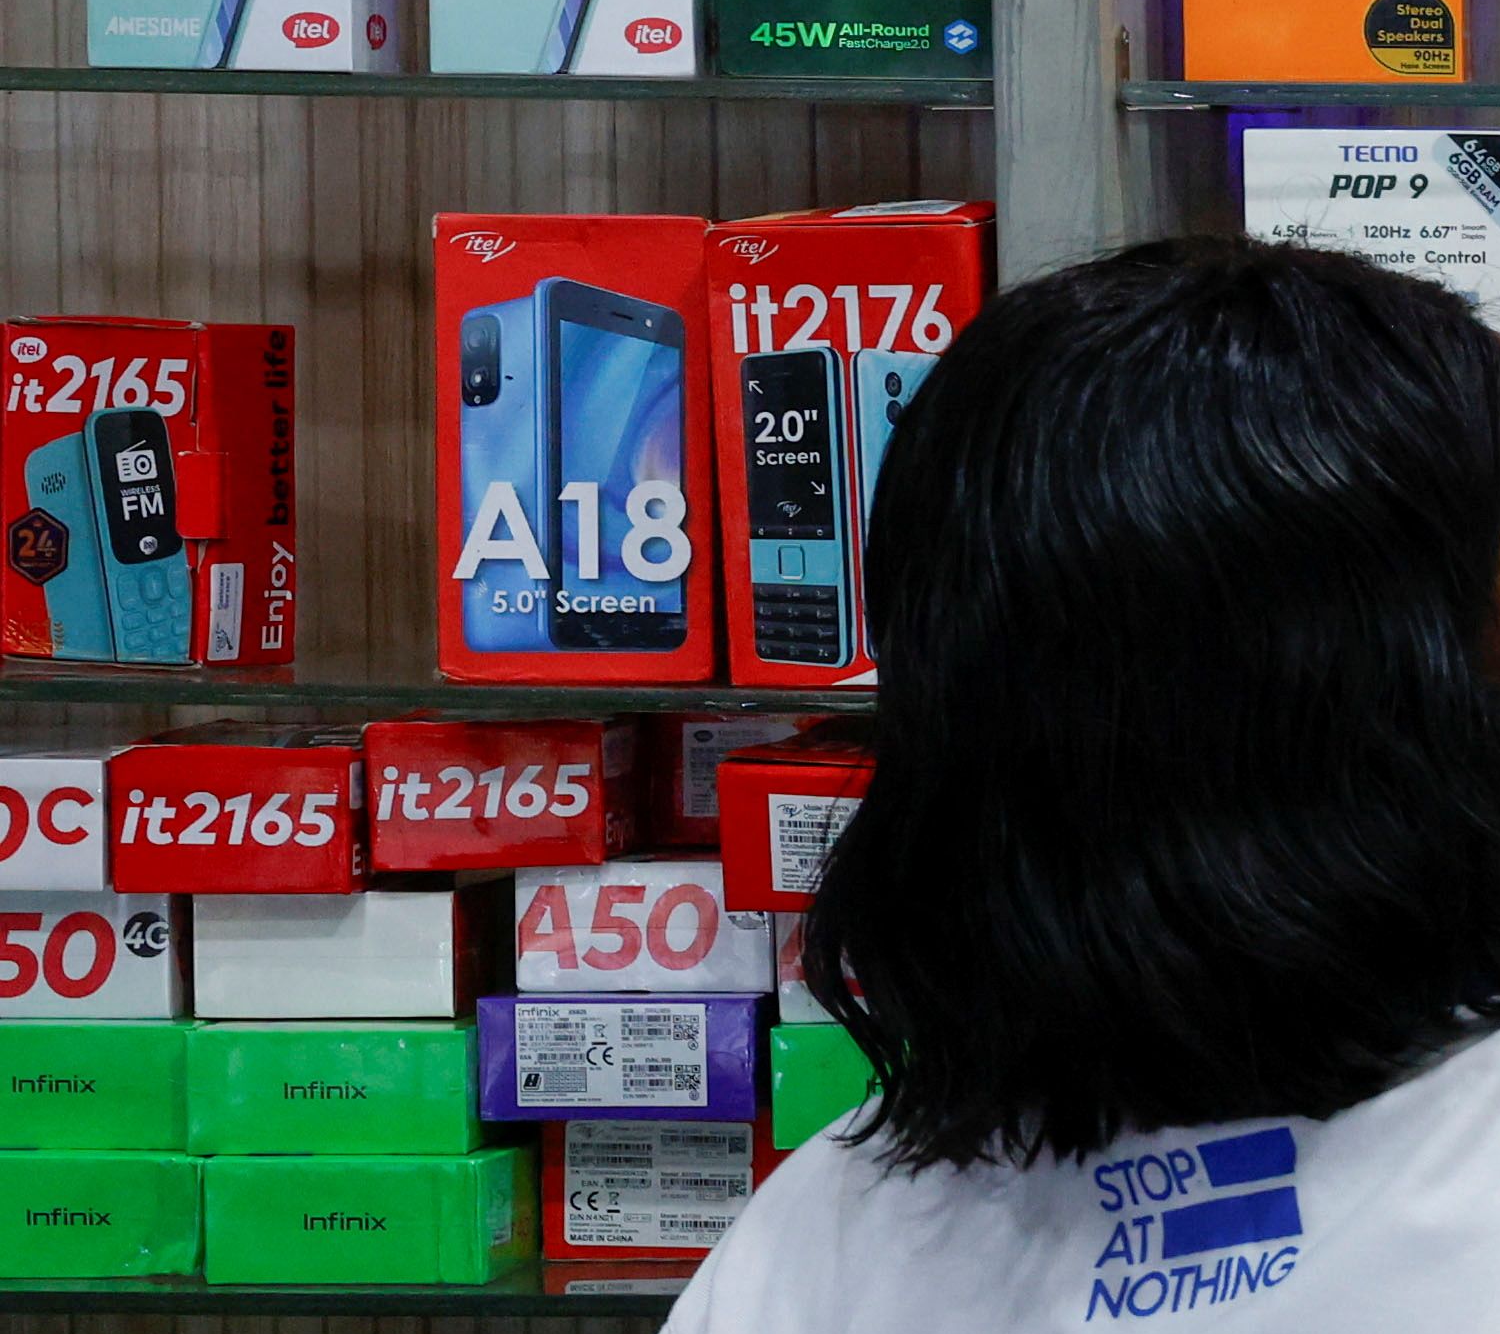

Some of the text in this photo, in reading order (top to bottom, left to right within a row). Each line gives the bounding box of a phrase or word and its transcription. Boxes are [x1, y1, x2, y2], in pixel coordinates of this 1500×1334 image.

[1396, 4, 1444, 17] Stereo
[1410, 17, 1444, 29] Dual
[290, 18, 332, 43] itel
[633, 23, 674, 49] itel
[750, 21, 930, 47] 45W All-Round
[1378, 30, 1444, 44] Speakers
[839, 38, 930, 51] FastCharge2.0
[1414, 50, 1450, 63] 90Hz
[1329, 174, 1428, 199] POP 9
[732, 284, 956, 353] it2176
[18, 343, 40, 356] itel
[7, 355, 188, 417] it2165
[754, 409, 818, 443] 2.0"
[756, 449, 820, 465] Screen
[262, 331, 294, 649] Enjoy better life
[122, 496, 164, 521] FM
[452, 479, 694, 581] A18
[492, 587, 656, 615] 5.0" Screen
[120, 789, 338, 846] it2165
[517, 883, 719, 973] A50
[12, 1075, 96, 1093] Infinix
[1094, 1149, 1196, 1212] STOP
[26, 1207, 111, 1227] Infinix
[570, 1234, 633, 1243] MADE IN CHINA
[1094, 1215, 1154, 1269] AT
[1086, 1247, 1298, 1321] NOTHING
